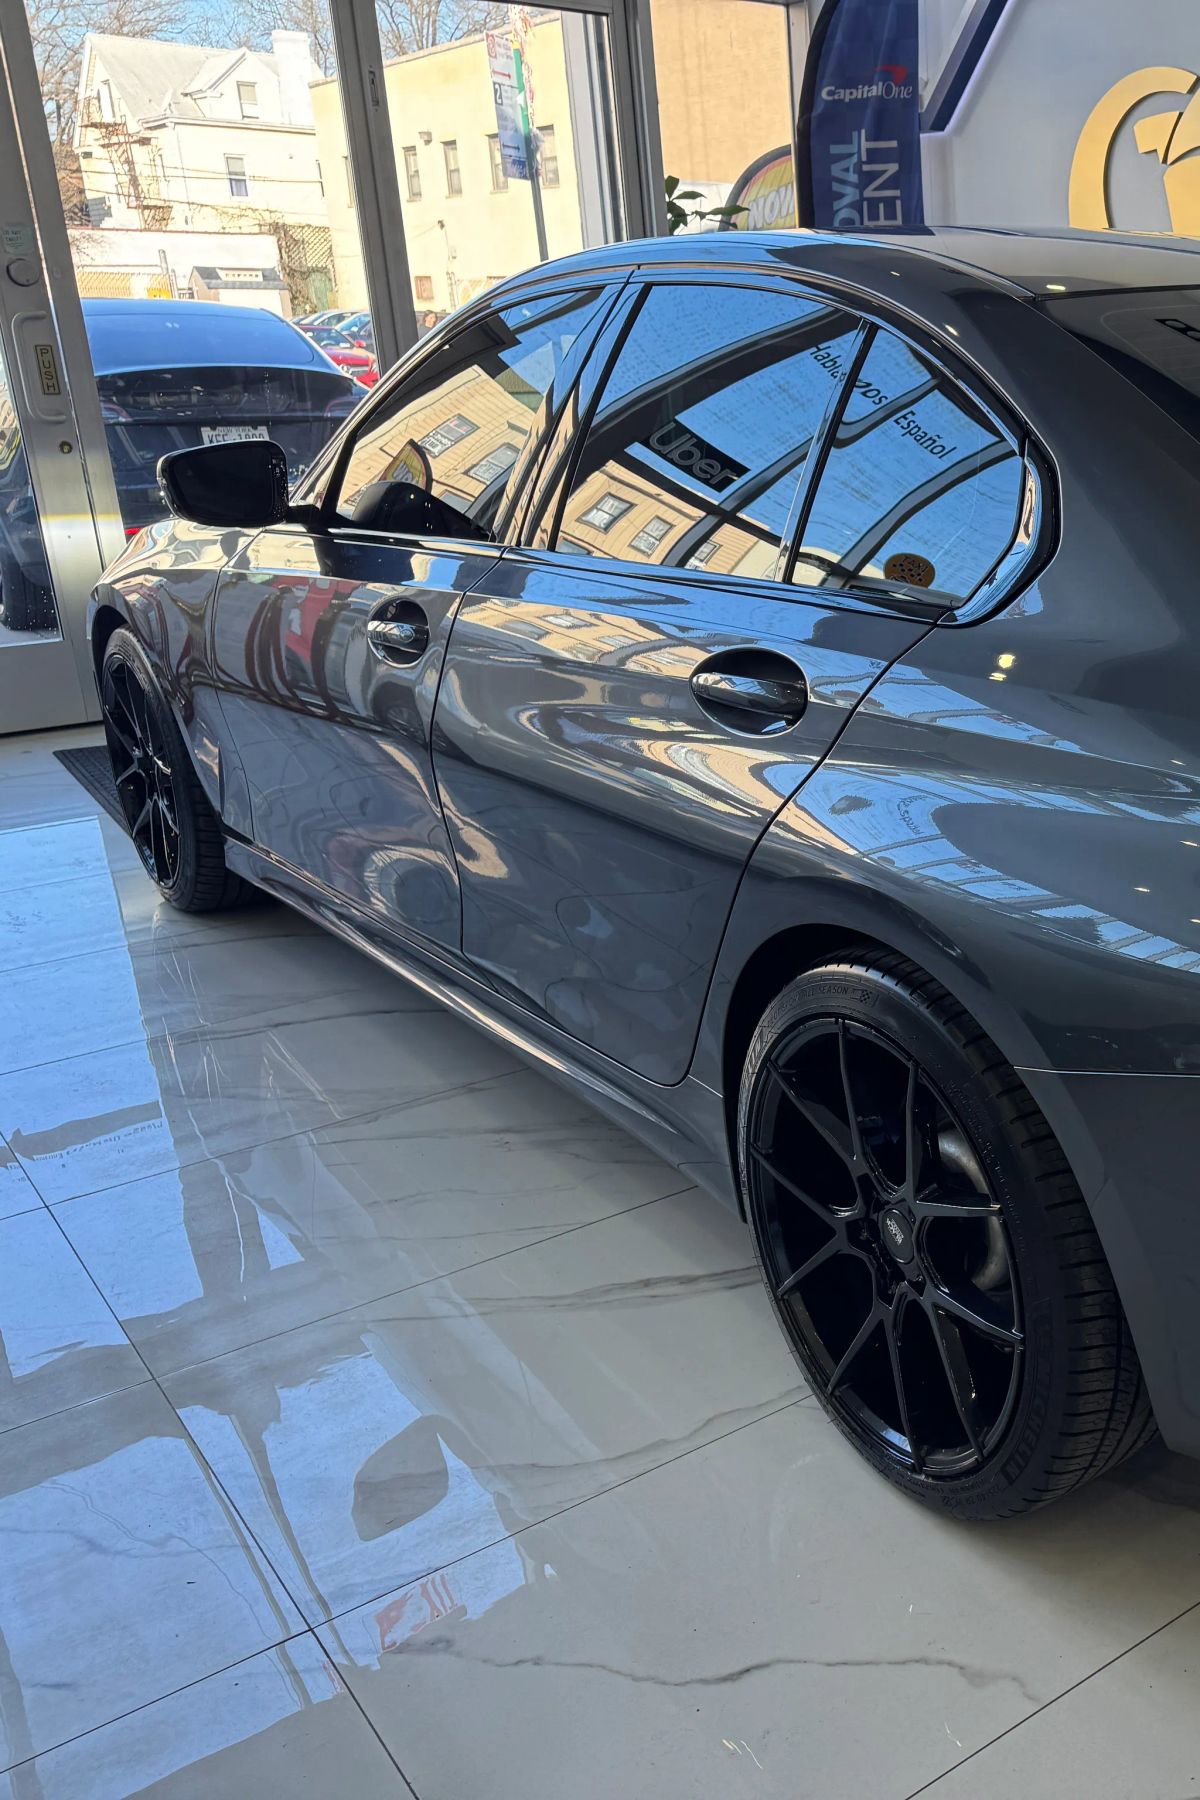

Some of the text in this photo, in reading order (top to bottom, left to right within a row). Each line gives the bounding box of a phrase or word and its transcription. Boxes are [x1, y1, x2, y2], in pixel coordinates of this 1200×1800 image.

[39, 348, 56, 392] PUSH
[649, 421, 738, 485] Uber
[892, 410, 957, 459] Español
